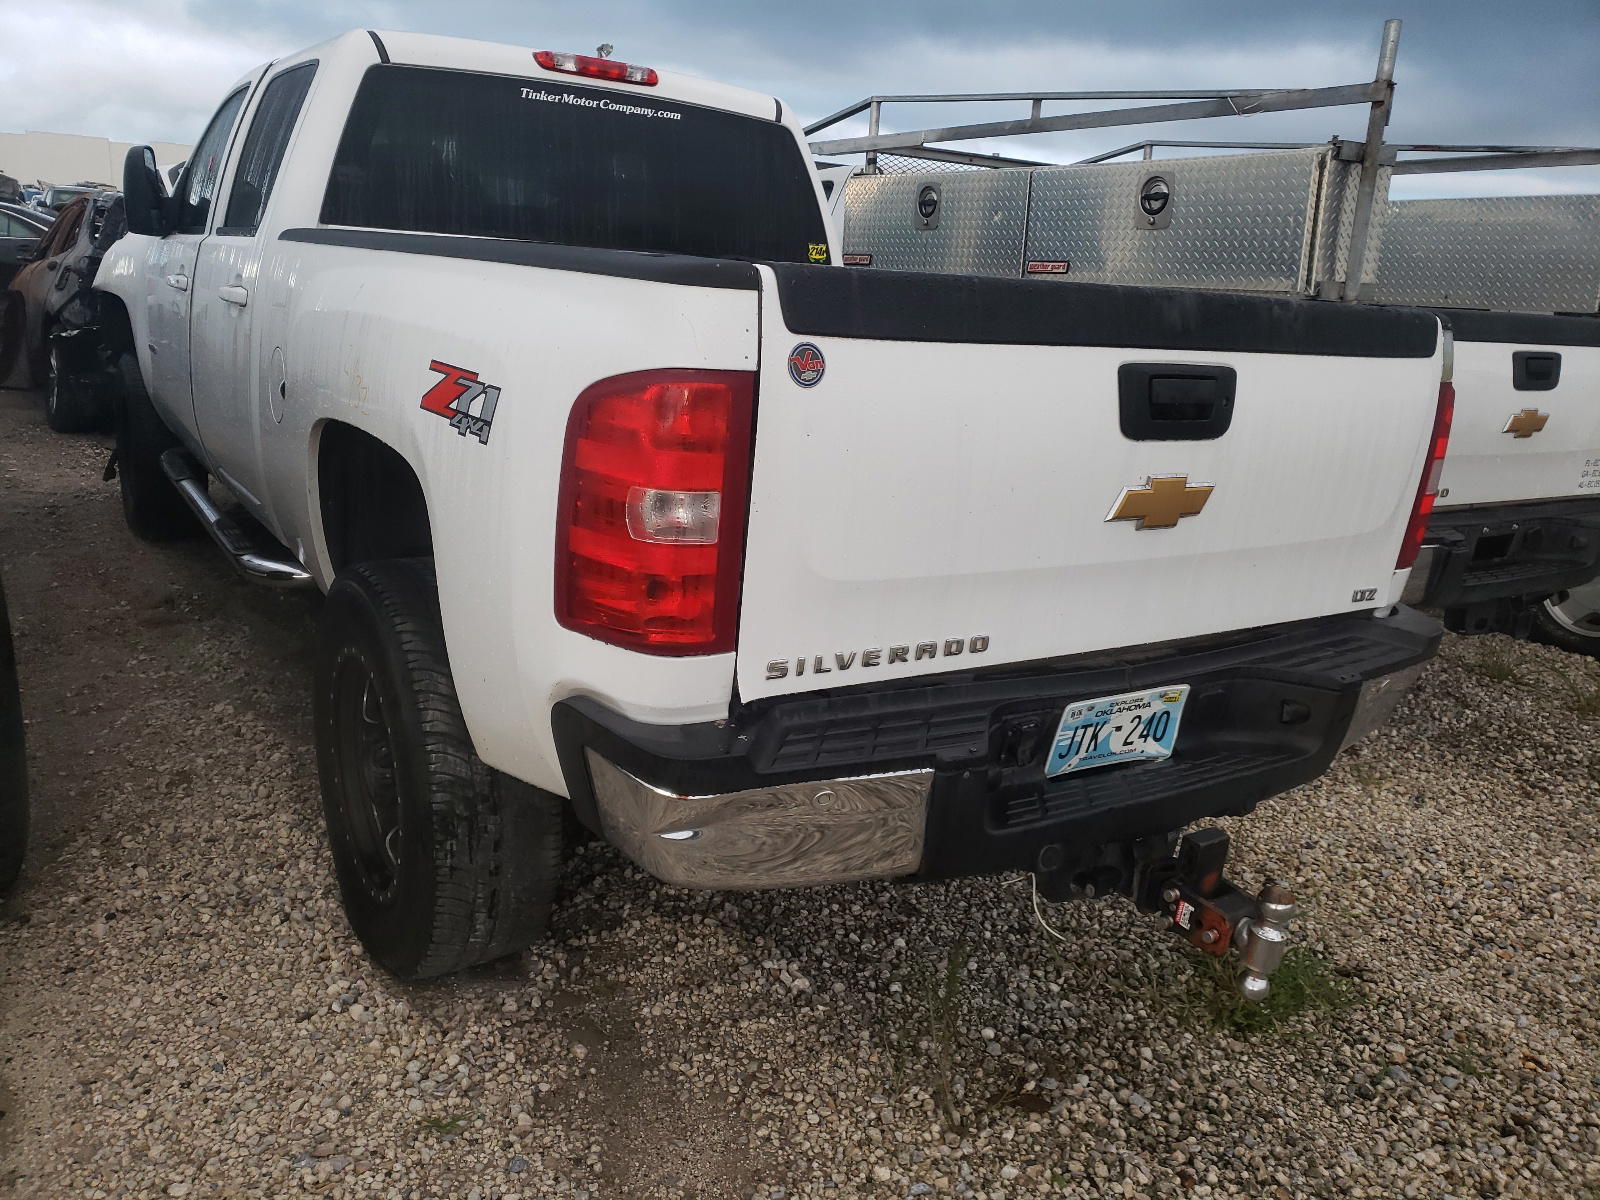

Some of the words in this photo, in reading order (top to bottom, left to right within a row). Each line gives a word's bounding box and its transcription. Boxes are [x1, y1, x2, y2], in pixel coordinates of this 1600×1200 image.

[1051, 264, 1066, 272] guard
[789, 350, 825, 371] Van
[420, 359, 501, 424] Z71
[1352, 587, 1378, 602] LTZ
[765, 634, 990, 681] SILVERADO
[1094, 701, 1151, 718] OKLAHOMA
[1109, 697, 1145, 708] EXPLORE
[1122, 710, 1171, 747] 240
[1079, 747, 1137, 761] TRAVELOK.COM
